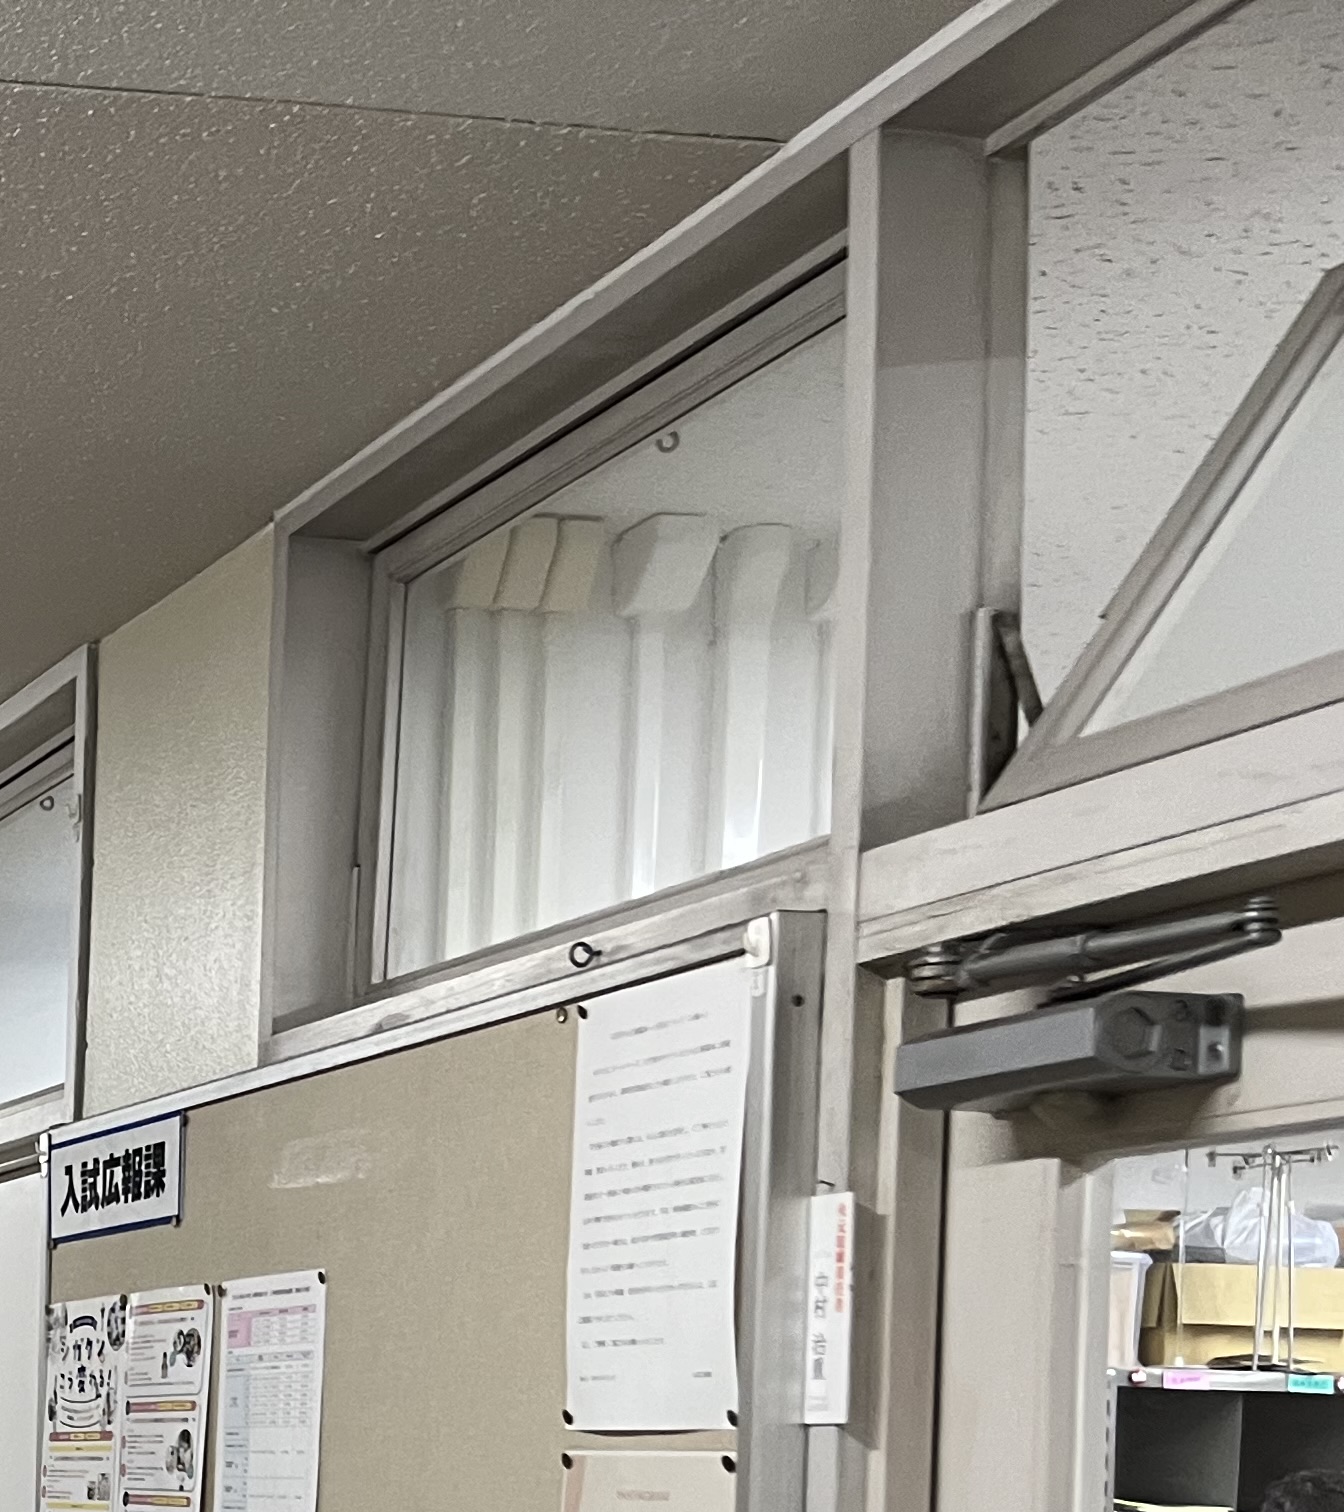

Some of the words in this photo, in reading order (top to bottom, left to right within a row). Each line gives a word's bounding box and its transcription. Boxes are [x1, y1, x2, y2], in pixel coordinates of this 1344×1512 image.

[60, 1140, 167, 1217] 入試広報課
